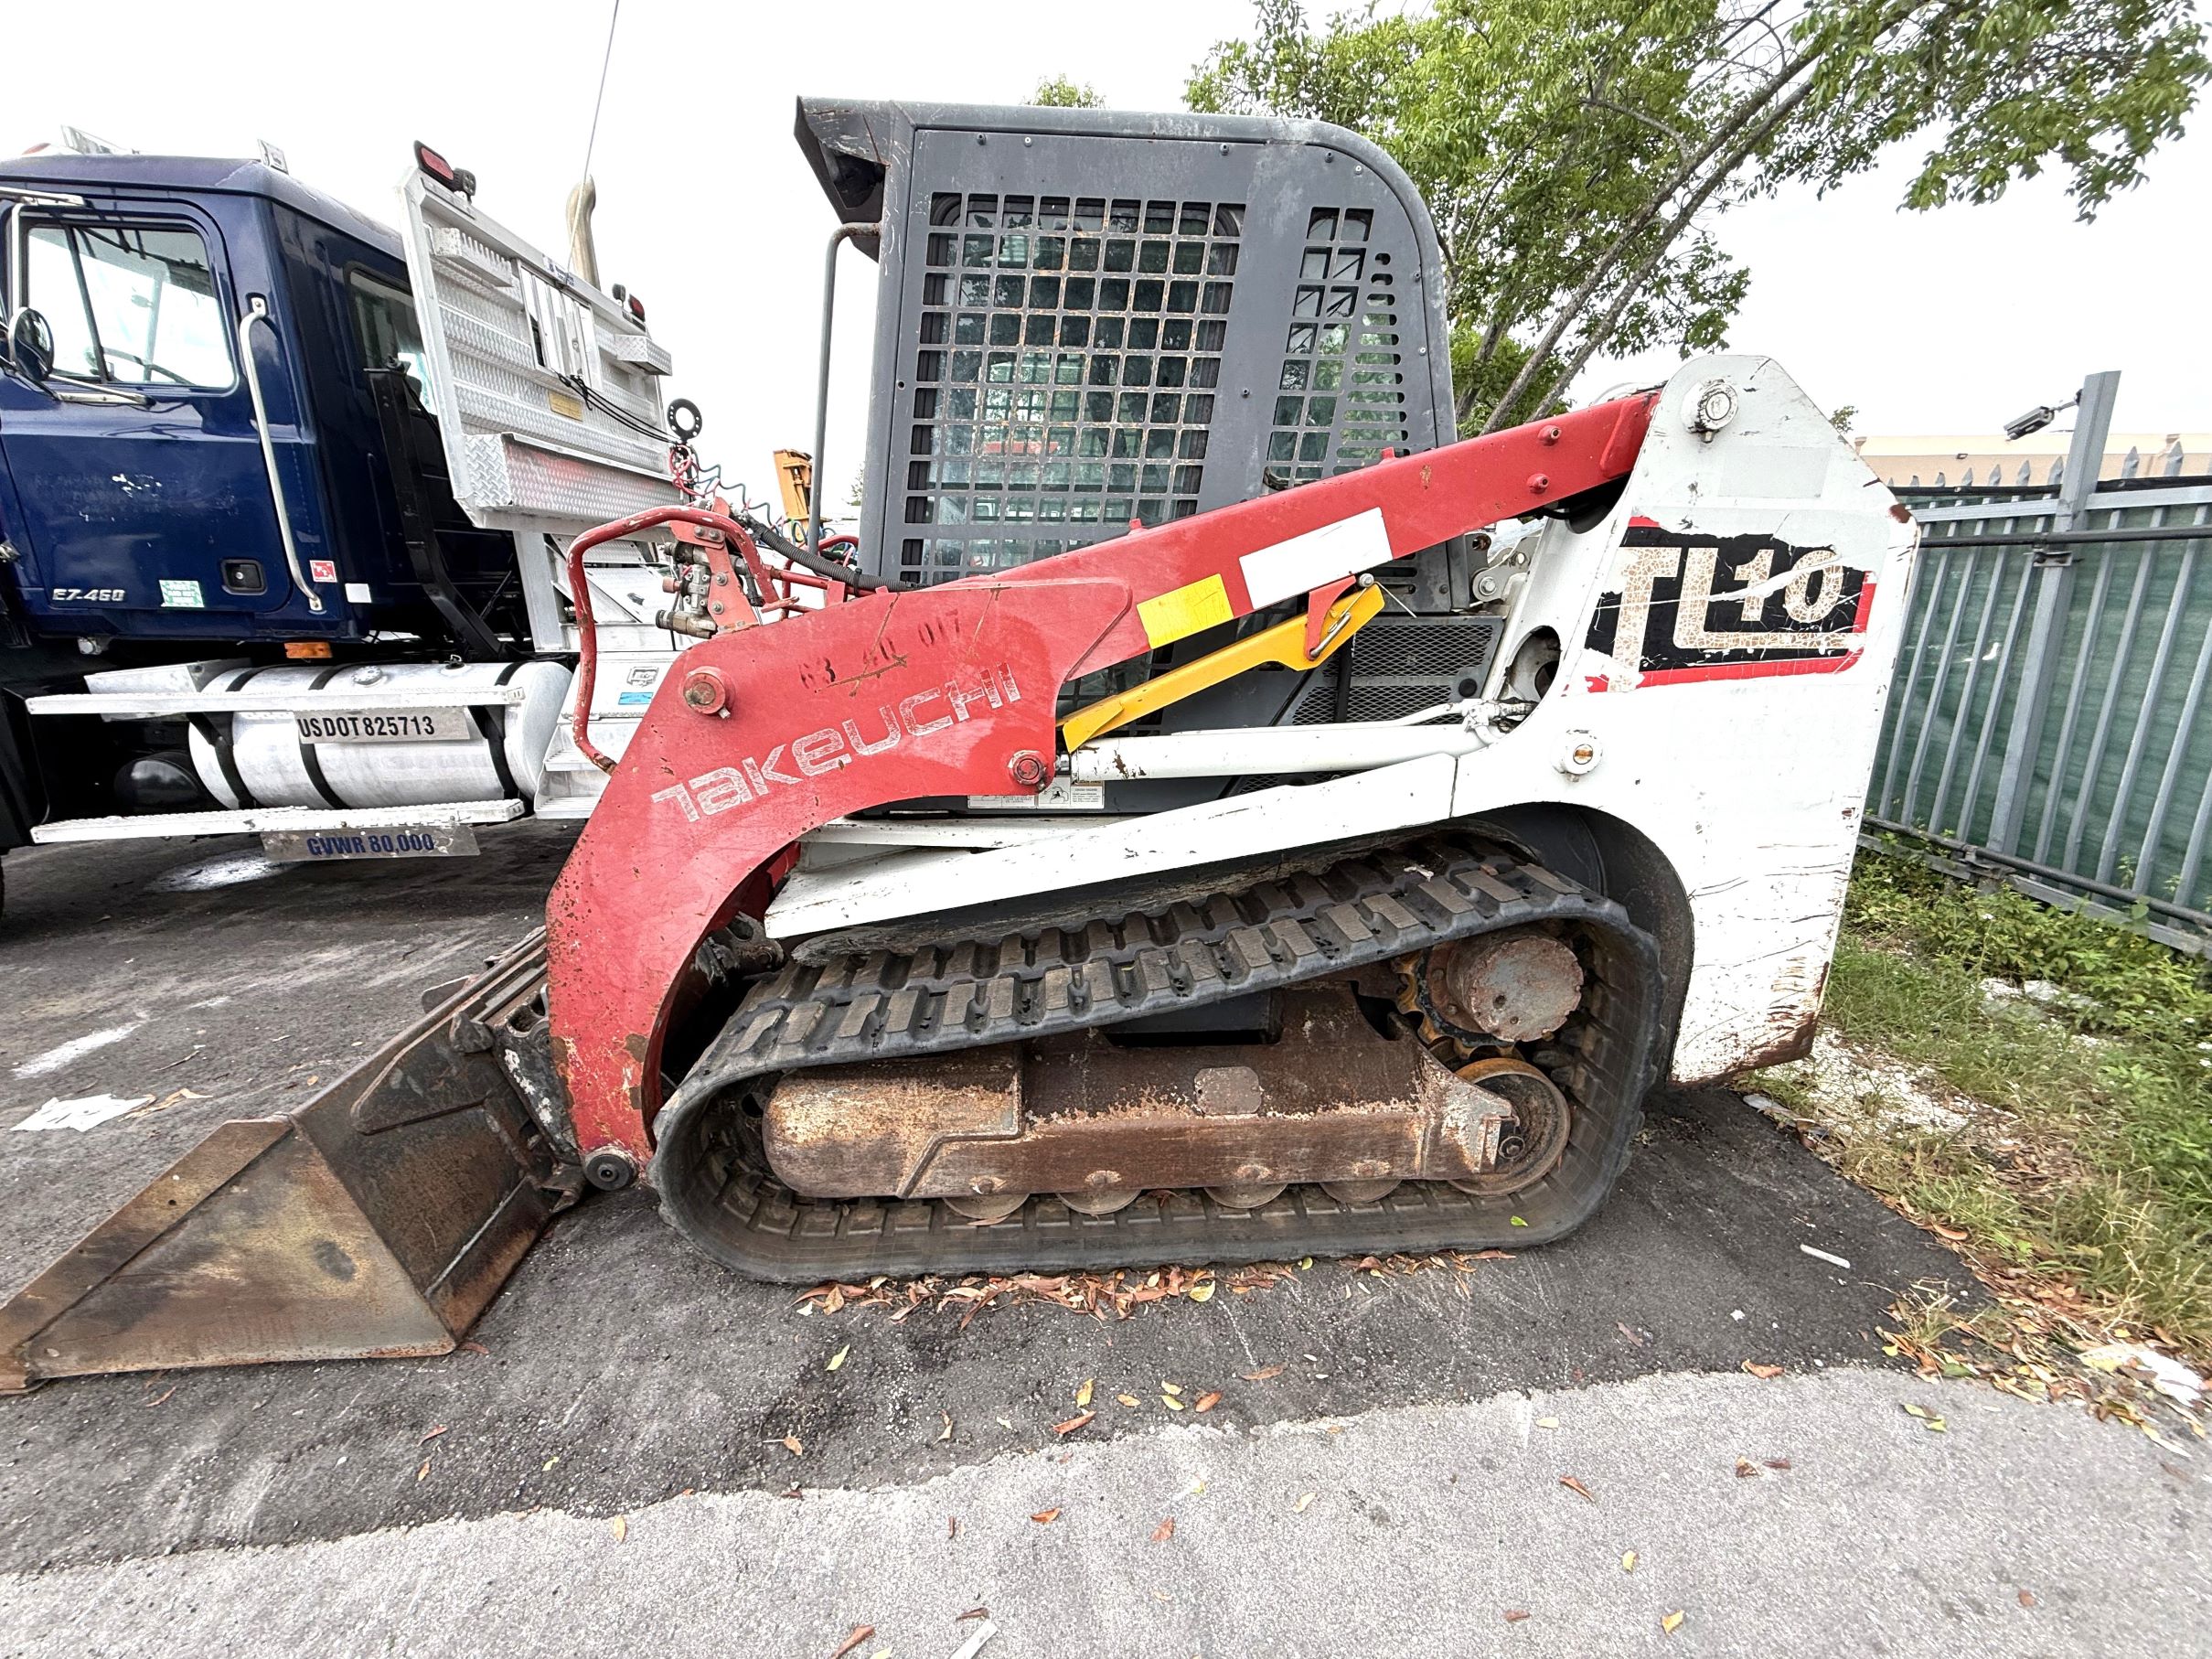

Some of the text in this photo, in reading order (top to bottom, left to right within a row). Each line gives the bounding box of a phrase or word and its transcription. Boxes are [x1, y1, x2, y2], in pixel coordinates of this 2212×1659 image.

[1607, 547, 1866, 692] TL10
[297, 715, 434, 737] USDOT 825713
[306, 833, 435, 856] GVWR 80,000
